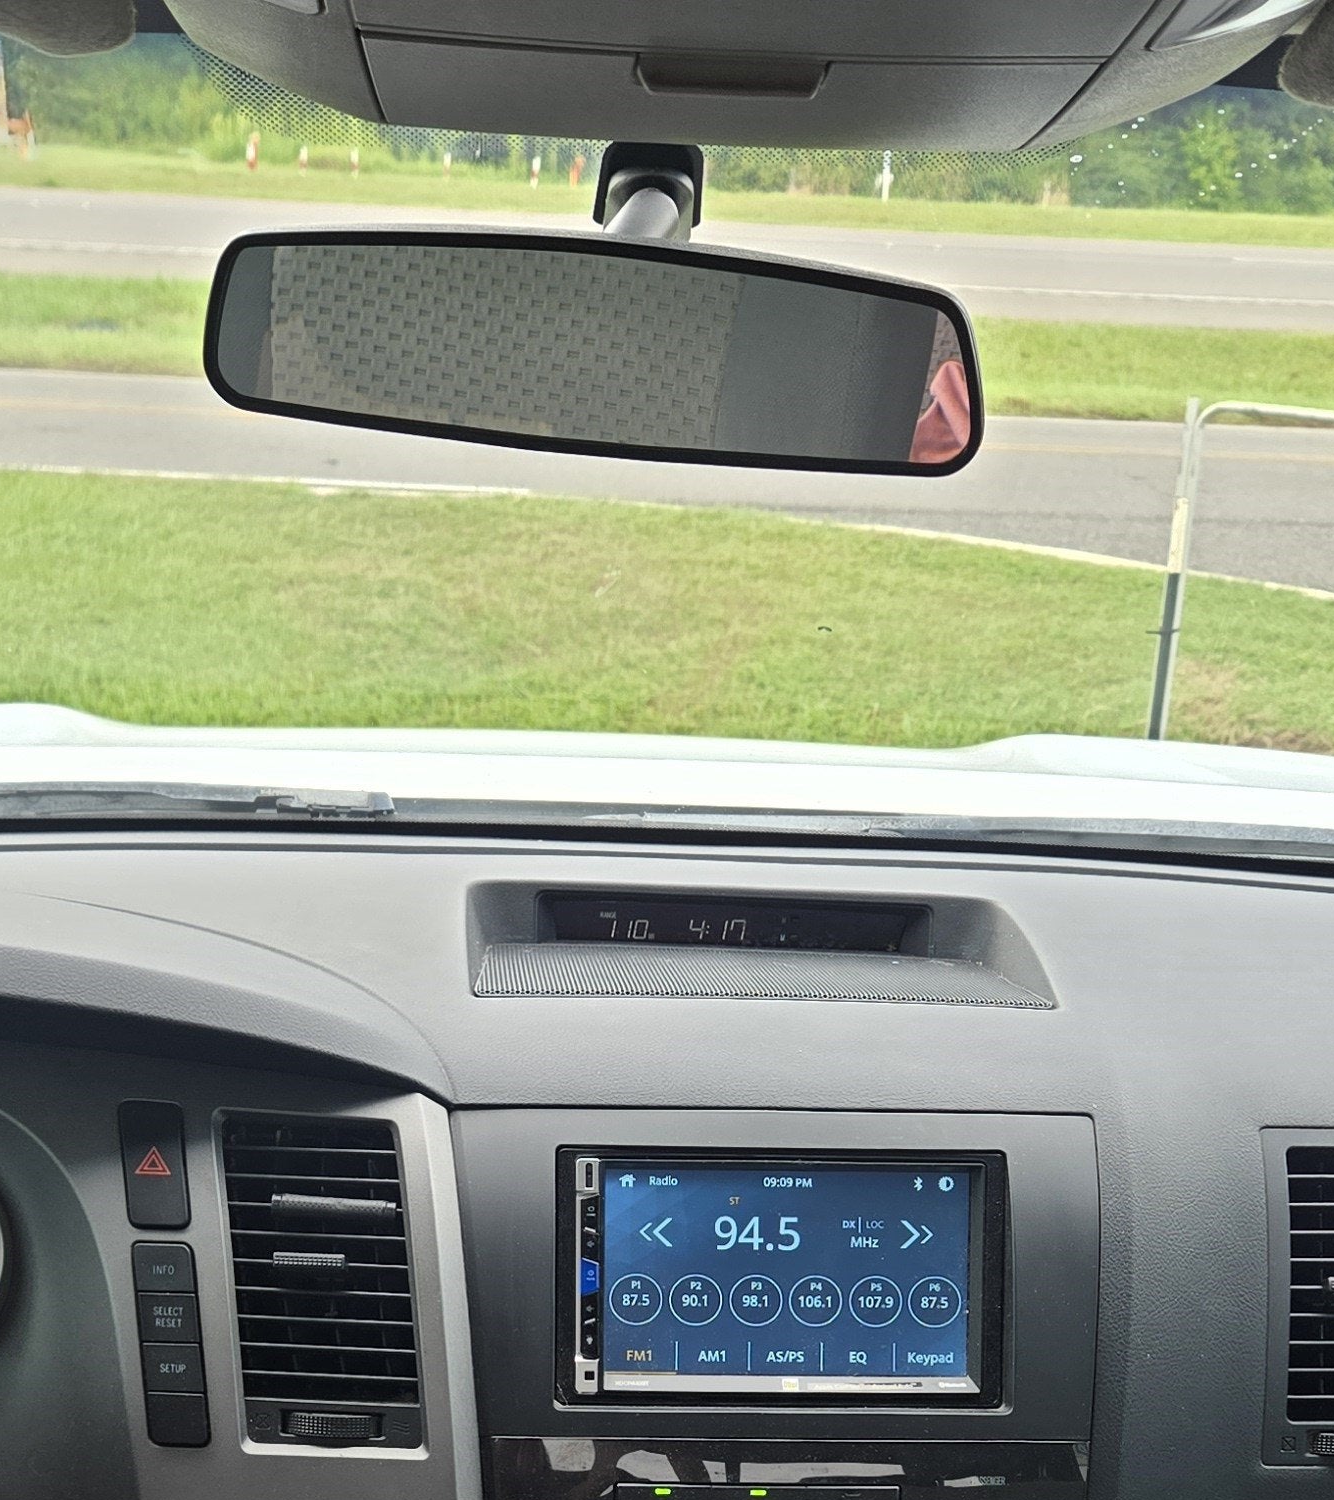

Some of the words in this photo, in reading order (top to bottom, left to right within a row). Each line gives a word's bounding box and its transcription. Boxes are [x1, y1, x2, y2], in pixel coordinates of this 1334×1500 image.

[689, 919, 747, 940] 4:17
[649, 1175, 678, 1187] Radio
[763, 1177, 793, 1188] 09:09
[795, 1178, 813, 1188] PM
[842, 1220, 856, 1229] DX
[865, 1220, 885, 1229] LOC
[714, 1215, 801, 1251] 94.5
[850, 1236, 879, 1248] MHz
[152, 1264, 175, 1276] INFO
[622, 1294, 650, 1306] 87.5
[681, 1294, 708, 1307] 90.1
[742, 1295, 768, 1308] 98.1
[798, 1296, 833, 1309] 106.1
[858, 1296, 894, 1309] 107.9
[920, 1296, 949, 1309] 87.5
[153, 1306, 184, 1317] SELECT
[155, 1318, 182, 1329] RESET
[626, 1350, 652, 1361] FM1
[698, 1350, 726, 1362] AM1
[766, 1350, 805, 1363] AS/PS
[849, 1352, 867, 1365] EQ
[907, 1351, 954, 1366] Keypad
[160, 1363, 187, 1374] SETUP
